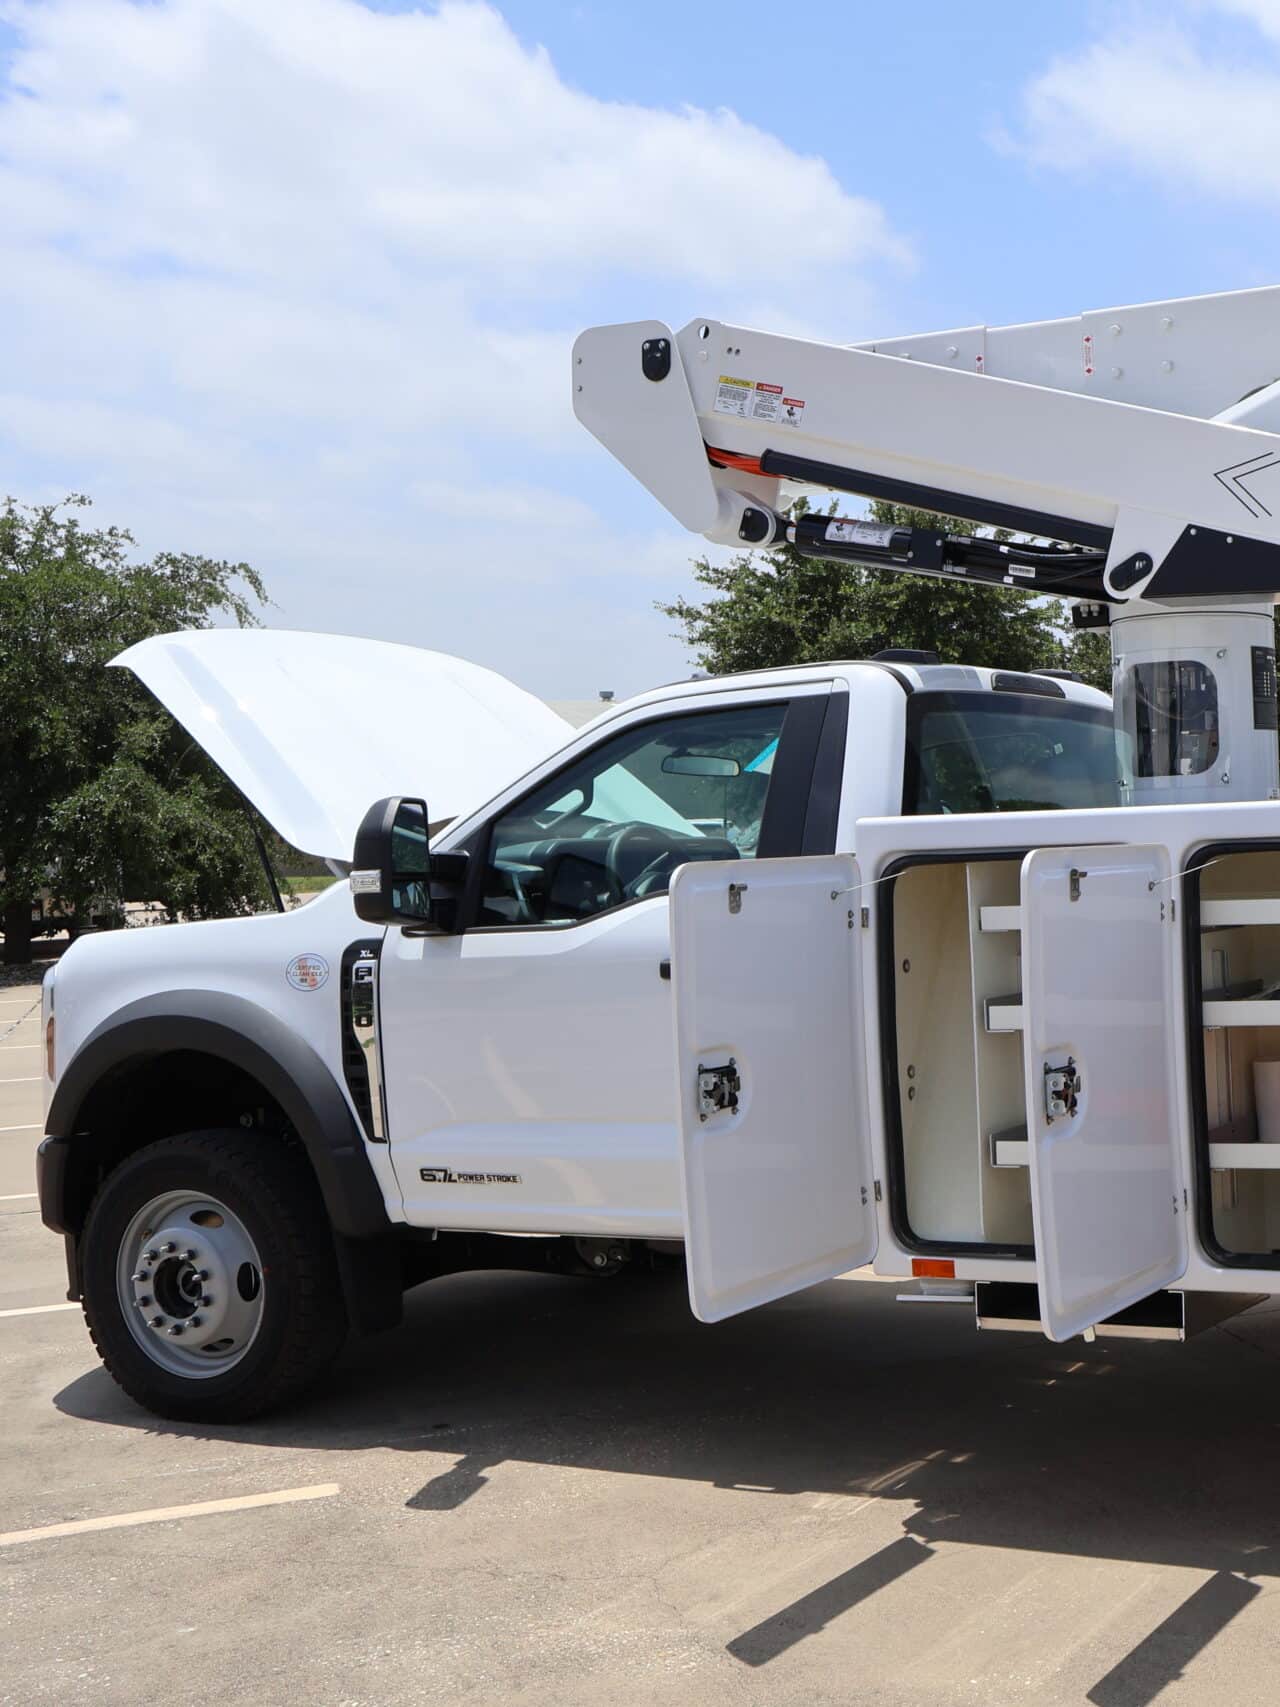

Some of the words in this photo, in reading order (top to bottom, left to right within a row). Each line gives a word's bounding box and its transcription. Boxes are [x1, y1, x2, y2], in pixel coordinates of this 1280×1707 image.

[419, 1168, 458, 1183] 6.7L
[458, 1173, 485, 1181] POWER
[487, 1174, 519, 1183] STROKE
